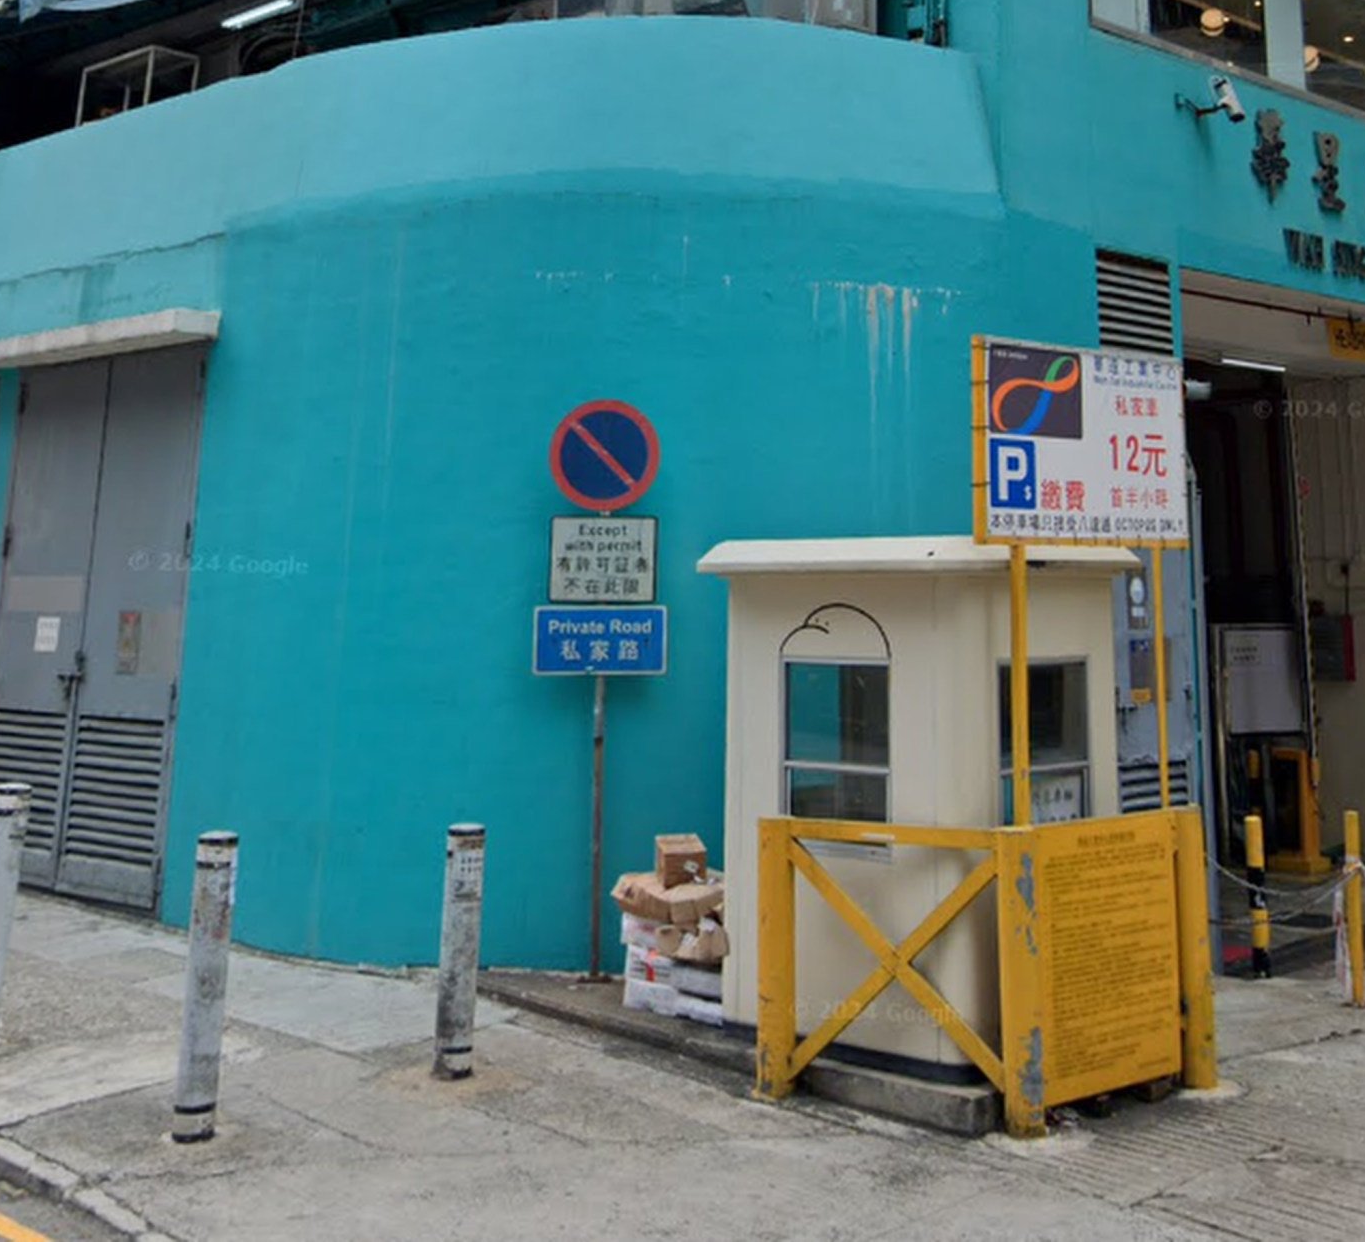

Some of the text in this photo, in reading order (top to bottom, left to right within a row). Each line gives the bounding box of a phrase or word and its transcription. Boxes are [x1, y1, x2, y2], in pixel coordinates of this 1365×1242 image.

[1115, 394, 1159, 418] 私家車
[1109, 434, 1168, 478] 12元
[997, 446, 1028, 502] P
[578, 523, 628, 539] Except
[564, 539, 643, 554] with permit
[563, 578, 640, 596] 不在此限
[547, 618, 653, 635] Private Road
[559, 638, 639, 663] 私家路
